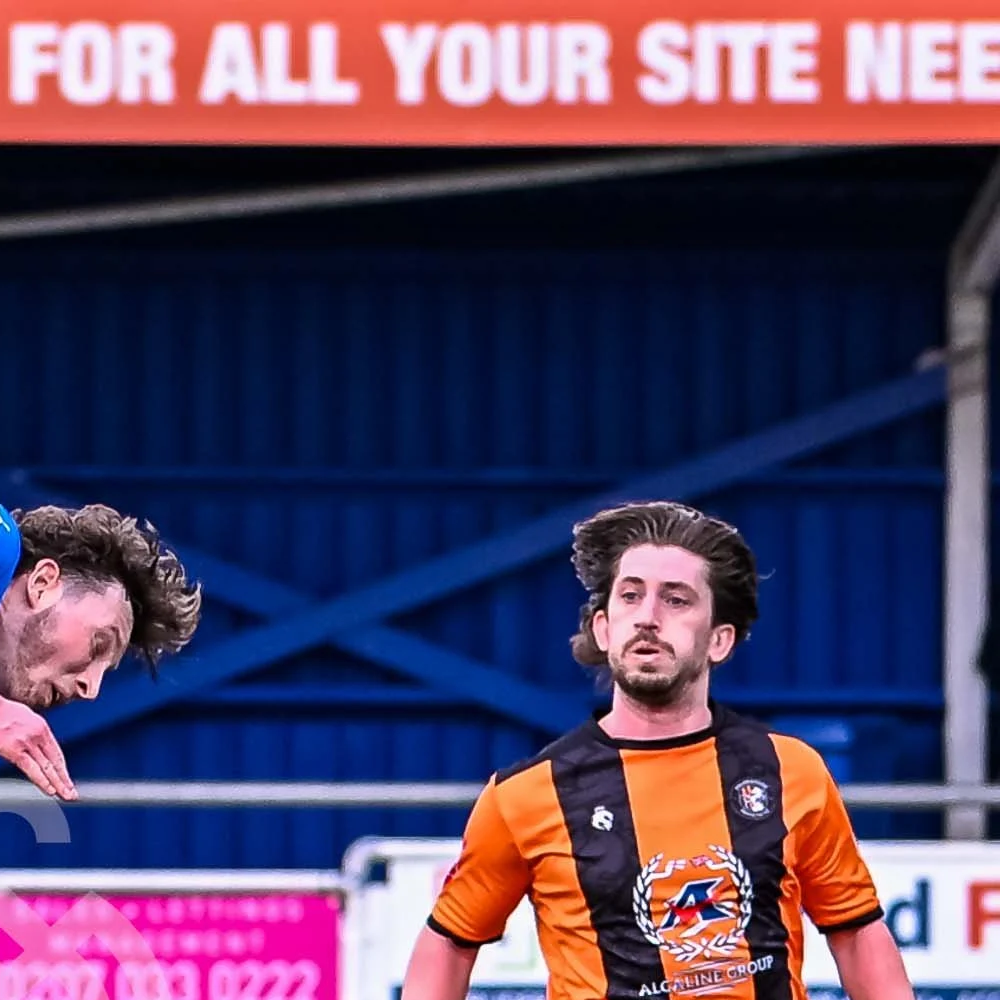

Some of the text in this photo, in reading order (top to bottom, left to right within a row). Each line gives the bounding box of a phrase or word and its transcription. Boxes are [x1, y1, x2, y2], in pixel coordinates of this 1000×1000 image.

[9, 22, 175, 105] FOR
[199, 22, 360, 105] ALL
[381, 22, 612, 106] YOUR
[637, 22, 820, 104] SITE
[726, 954, 774, 979] GROUP
